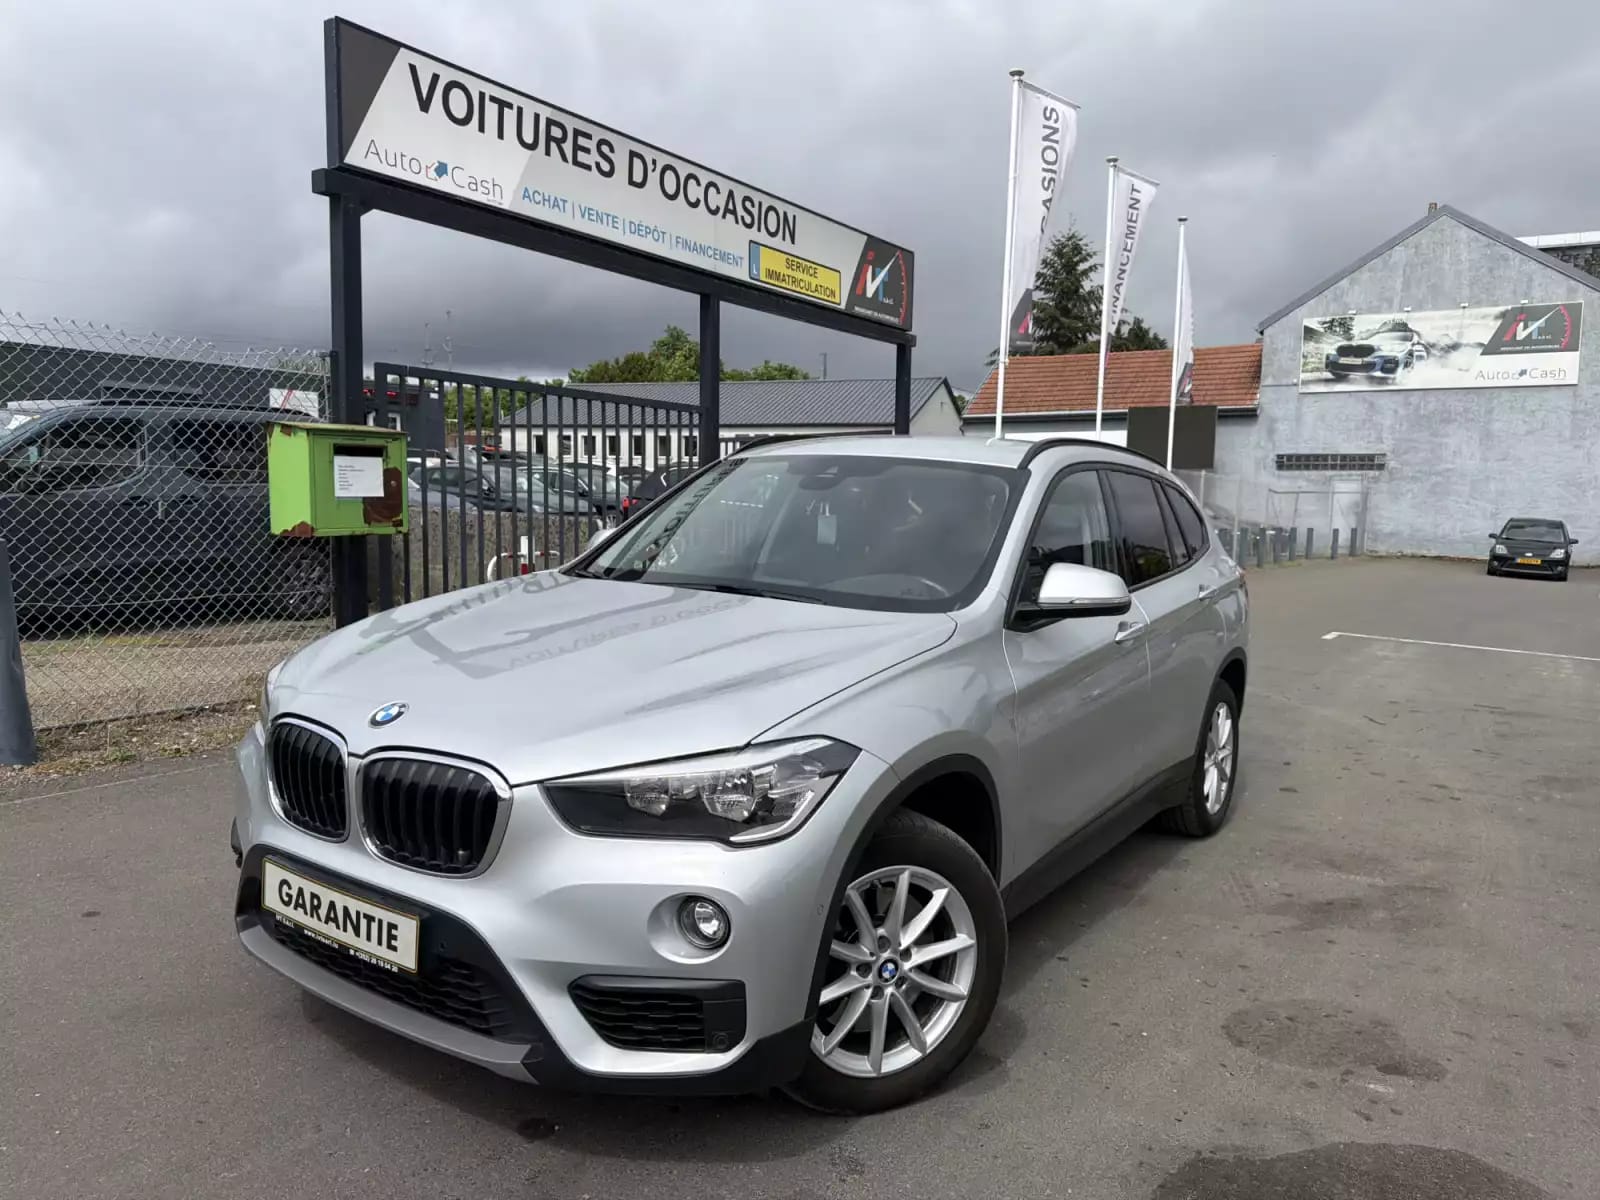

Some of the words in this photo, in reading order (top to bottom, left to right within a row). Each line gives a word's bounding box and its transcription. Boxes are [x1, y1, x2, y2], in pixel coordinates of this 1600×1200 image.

[364, 139, 422, 175] Auto
[451, 166, 503, 200] Cash
[408, 63, 616, 179] VOITURES
[628, 149, 796, 245] D'OCCASION
[522, 186, 568, 214] ACHAT
[579, 204, 620, 230] VENTE
[629, 219, 667, 244] DÉPÔT
[675, 236, 745, 268] FINANCEMENT
[765, 268, 836, 299] IMMATRICULATION
[785, 258, 819, 279] SERVICE
[1528, 367, 1567, 379] Cash
[278, 879, 398, 952] GARANTIE
